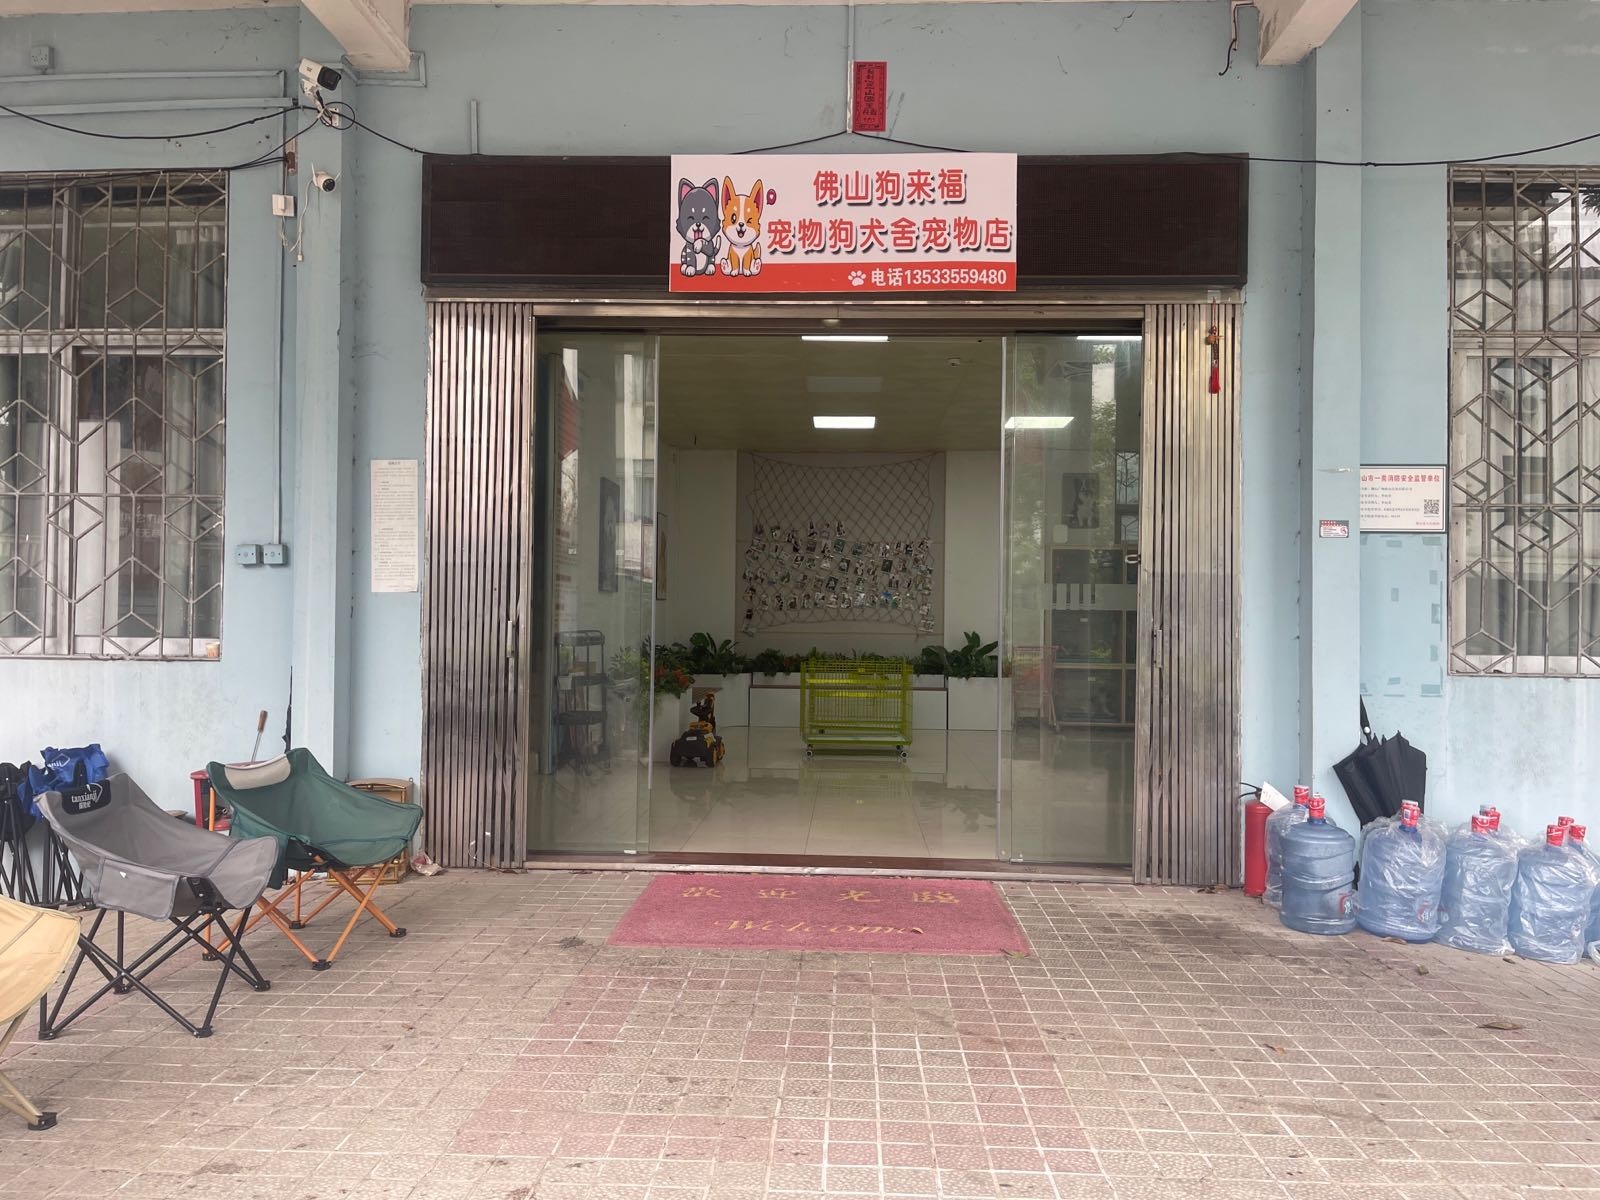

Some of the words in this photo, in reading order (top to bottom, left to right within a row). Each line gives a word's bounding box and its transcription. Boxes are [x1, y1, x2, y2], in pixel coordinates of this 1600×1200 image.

[812, 167, 967, 205] 佛山狗来福
[766, 216, 1012, 254] 宠物狗犬舍宠物店
[870, 267, 1008, 287] 电话13533559480
